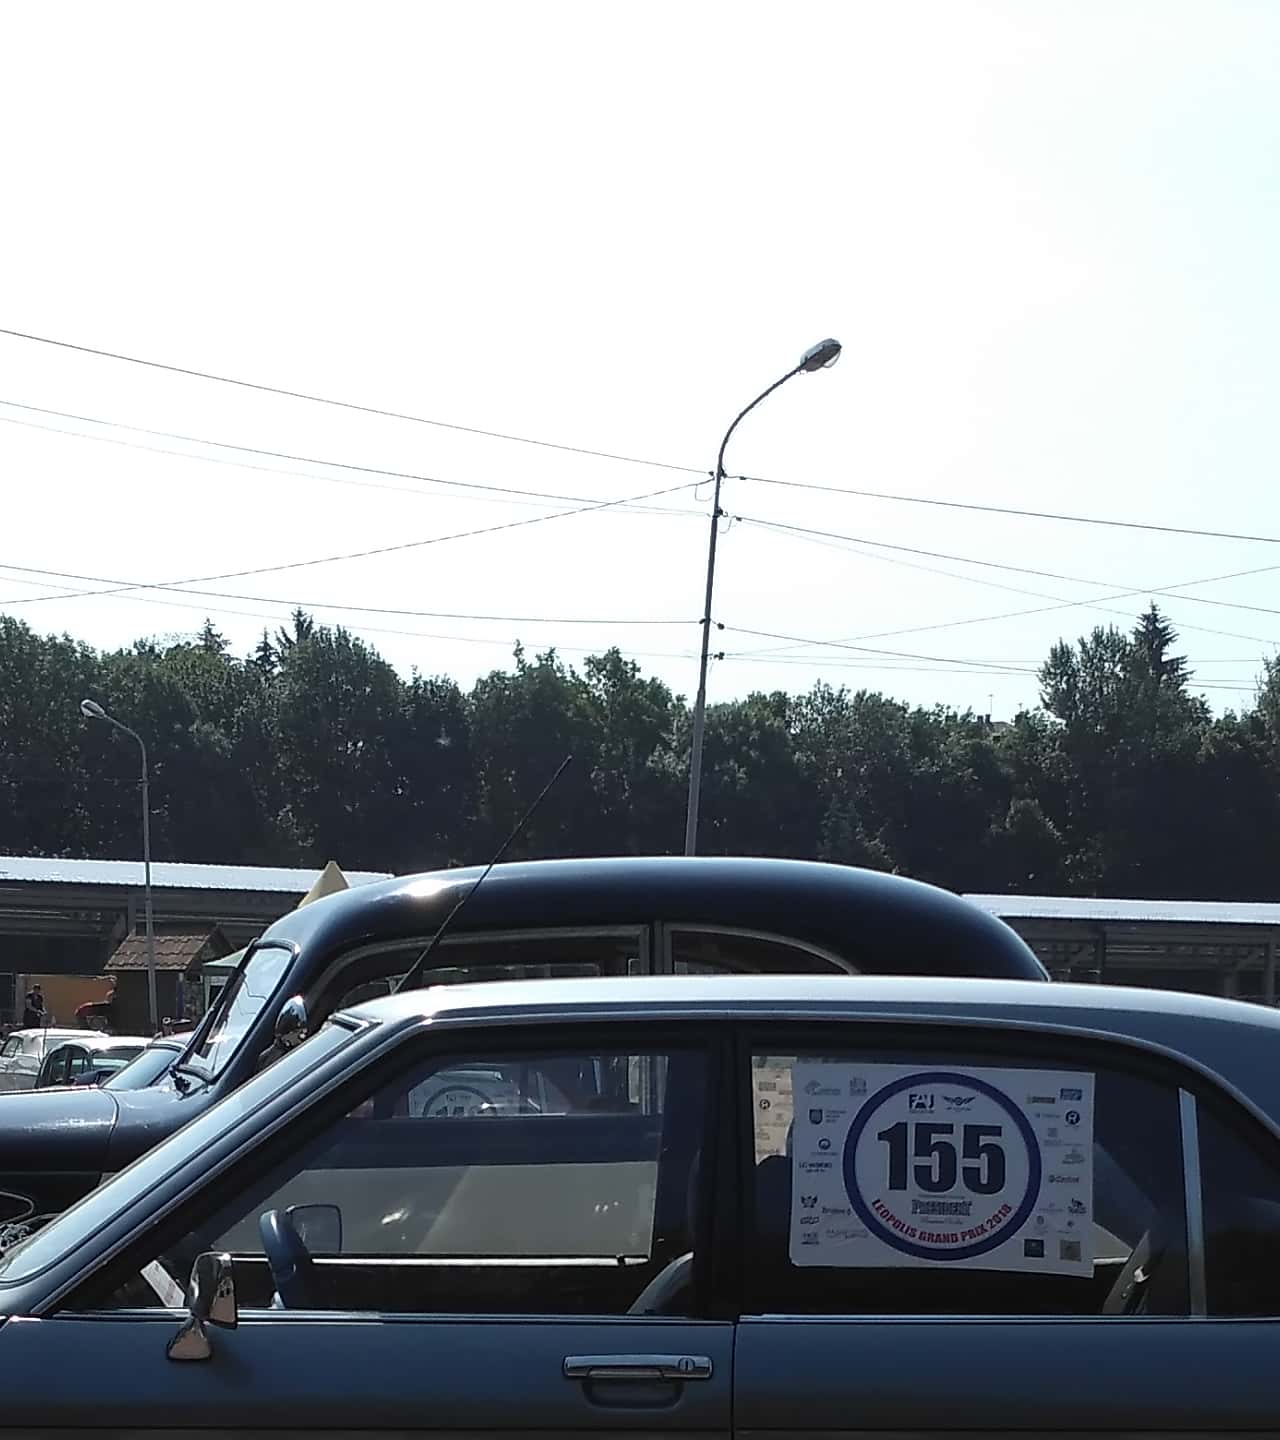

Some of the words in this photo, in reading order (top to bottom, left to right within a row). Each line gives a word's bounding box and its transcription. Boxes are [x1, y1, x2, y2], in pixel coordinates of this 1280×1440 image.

[877, 1121, 1005, 1195] 155
[871, 1199, 918, 1238] LEOPOLIS
[918, 1230, 959, 1244] GRAND
[960, 1224, 988, 1242] PRIX
[985, 1203, 1013, 1229] 2018
